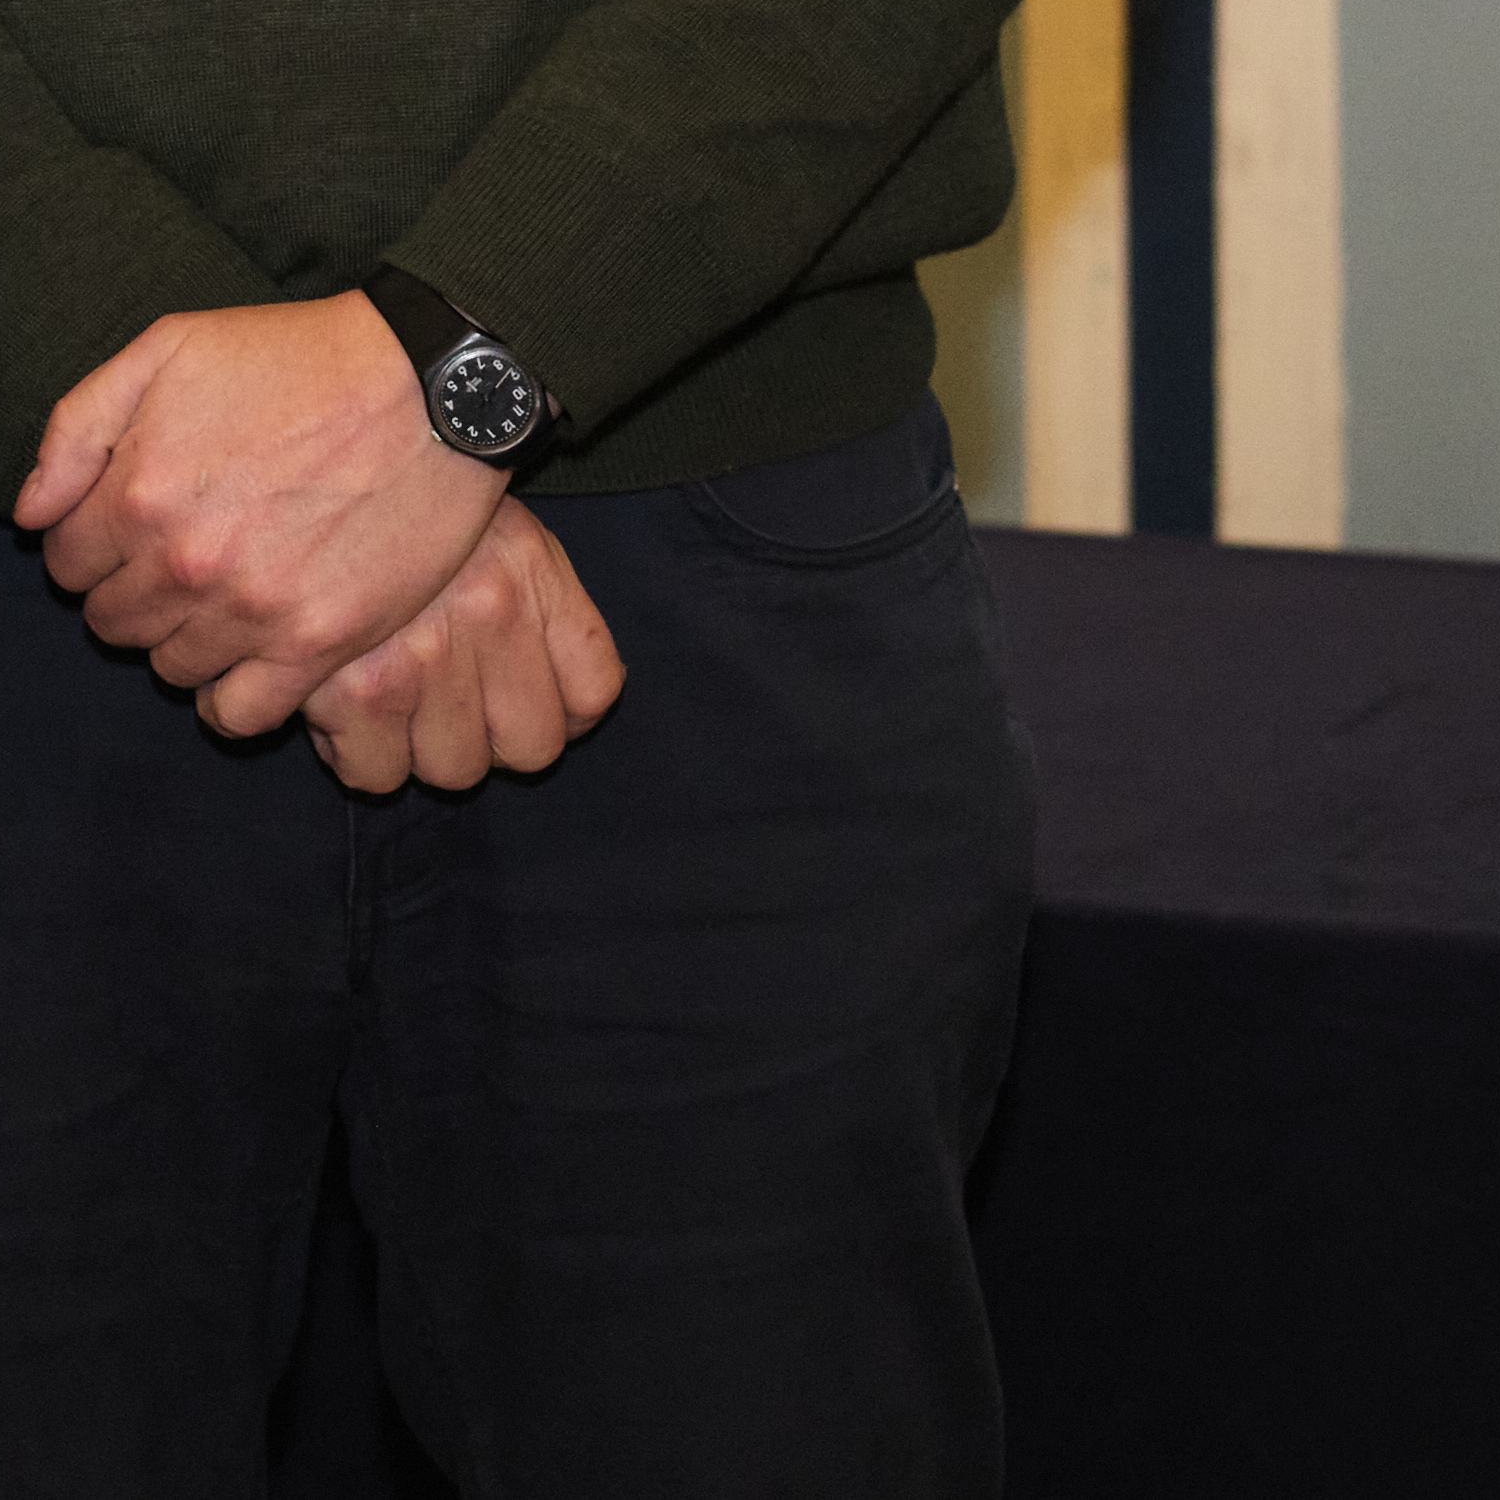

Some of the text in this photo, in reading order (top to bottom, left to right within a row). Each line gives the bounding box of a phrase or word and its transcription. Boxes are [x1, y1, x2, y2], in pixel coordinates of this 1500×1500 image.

[493, 360, 503, 370] 8
[447, 381, 458, 392] 5
[512, 386, 527, 400] 10
[445, 400, 453, 411] 4
[452, 417, 462, 428] 3
[501, 419, 516, 432] 12
[467, 426, 478, 437] 2
